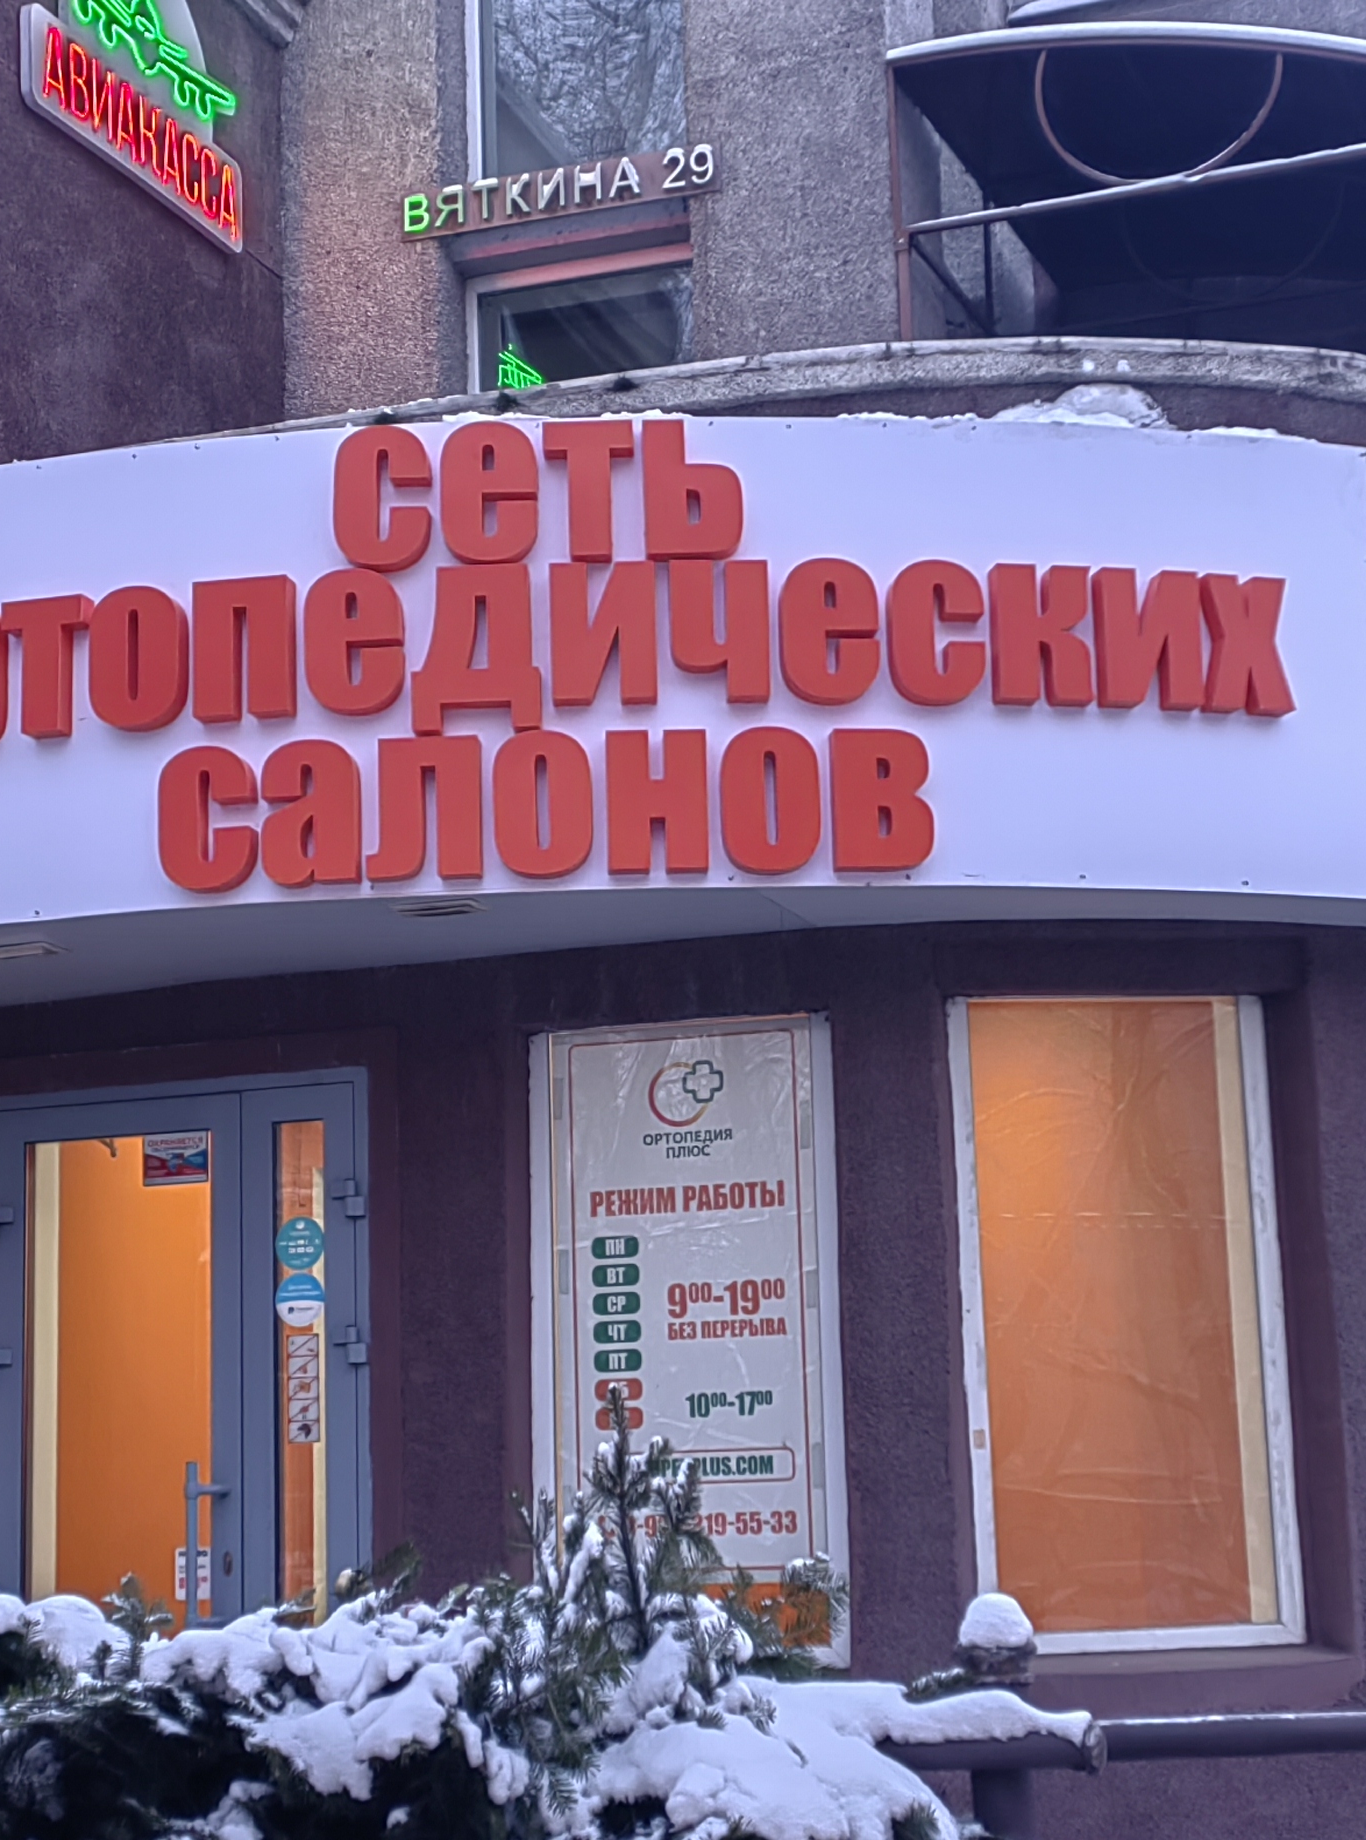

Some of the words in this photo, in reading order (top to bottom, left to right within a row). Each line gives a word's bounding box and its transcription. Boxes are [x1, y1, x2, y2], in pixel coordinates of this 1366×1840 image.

[43, 26, 239, 241] АВИАКАССА
[403, 157, 640, 232] ВЯТКИНА
[662, 144, 714, 189] 29
[331, 418, 745, 572] сеть
[156, 726, 935, 894] салонов
[642, 1128, 733, 1146] ОРТОПЕДИЯ
[666, 1143, 711, 1159] ПЛЮС
[590, 1186, 676, 1218] РЕЖИМ
[683, 1180, 785, 1213] РАБОТЫ
[605, 1239, 626, 1256] ПН
[606, 1267, 626, 1284] ВТ
[606, 1296, 627, 1312] СР
[607, 1324, 627, 1341] ЧТ
[667, 1321, 697, 1340] БЕЗ
[701, 1317, 787, 1338] ПЕРЕРЫВА
[608, 1352, 628, 1371] ПТ
[607, 1381, 628, 1399] Б
